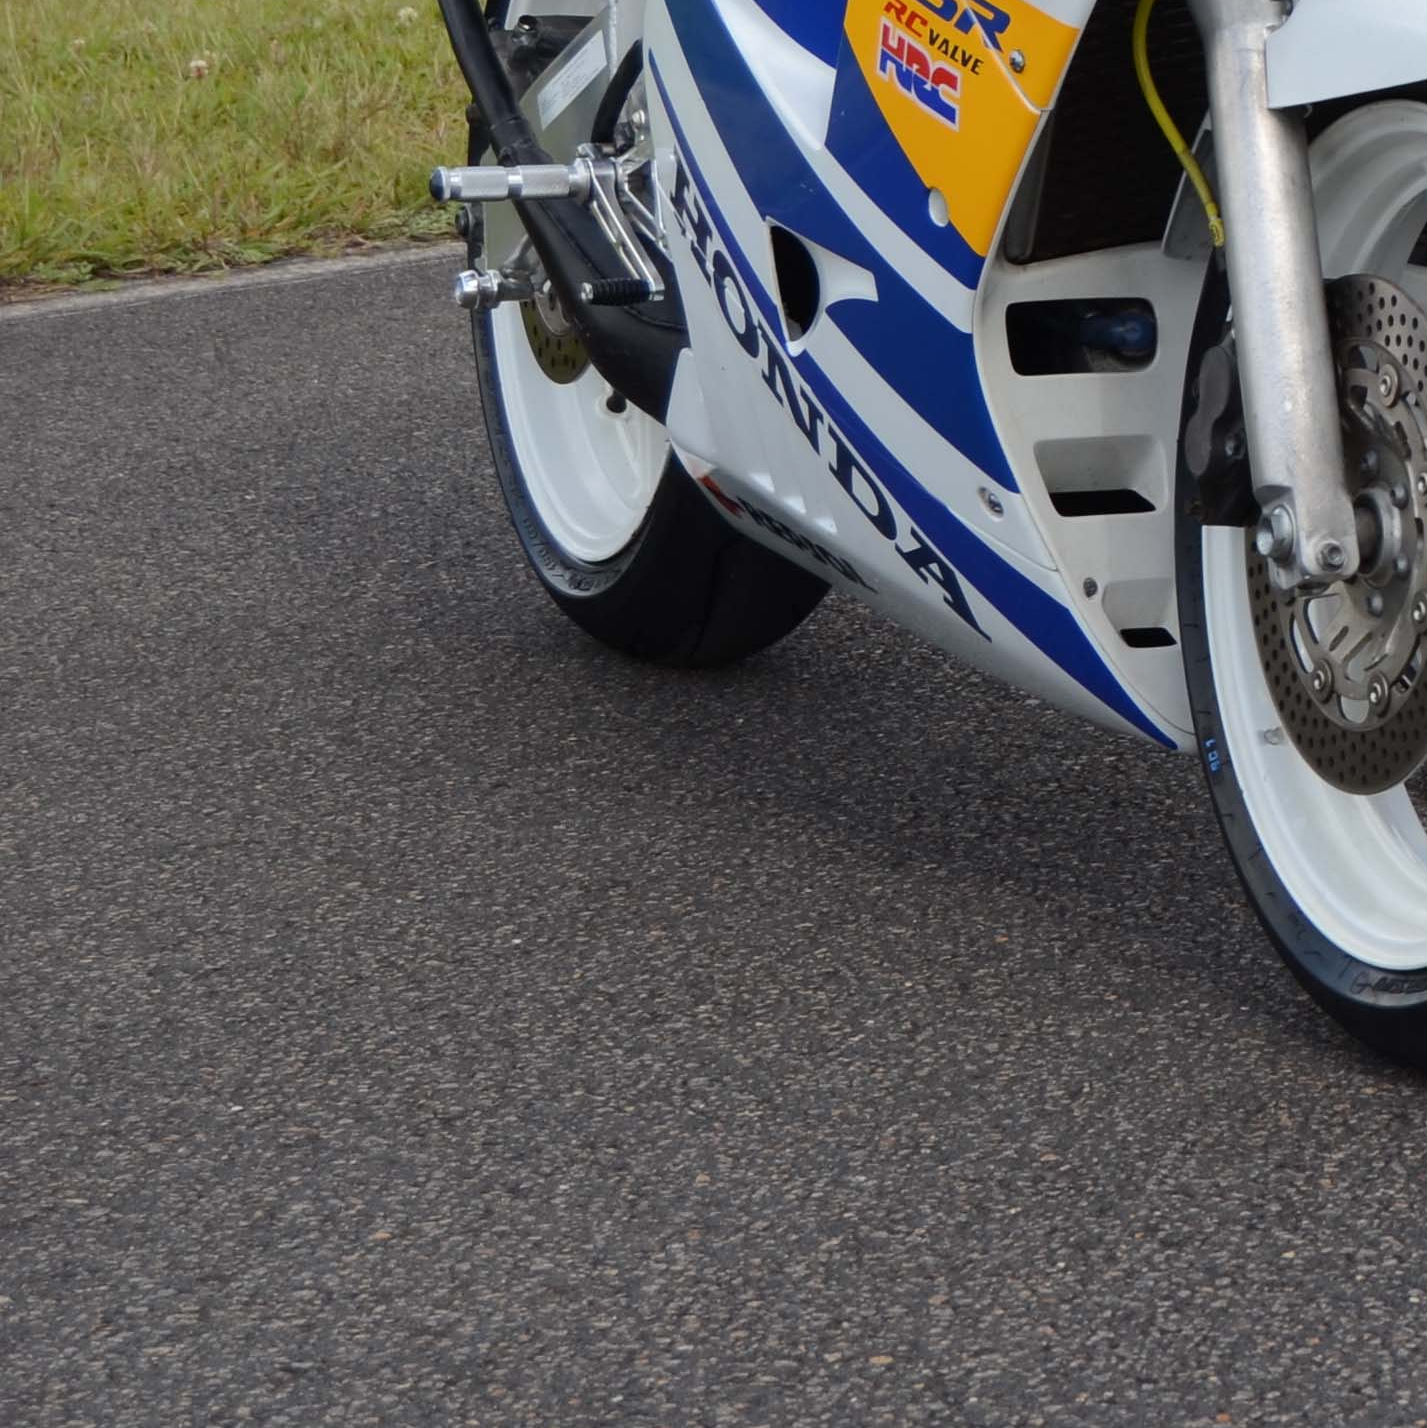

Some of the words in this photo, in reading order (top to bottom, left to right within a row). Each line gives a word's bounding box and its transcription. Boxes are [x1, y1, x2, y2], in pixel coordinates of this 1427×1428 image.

[879, 22, 959, 125] HRC
[928, 27, 985, 76] VALVE
[671, 145, 992, 644] HONDA
